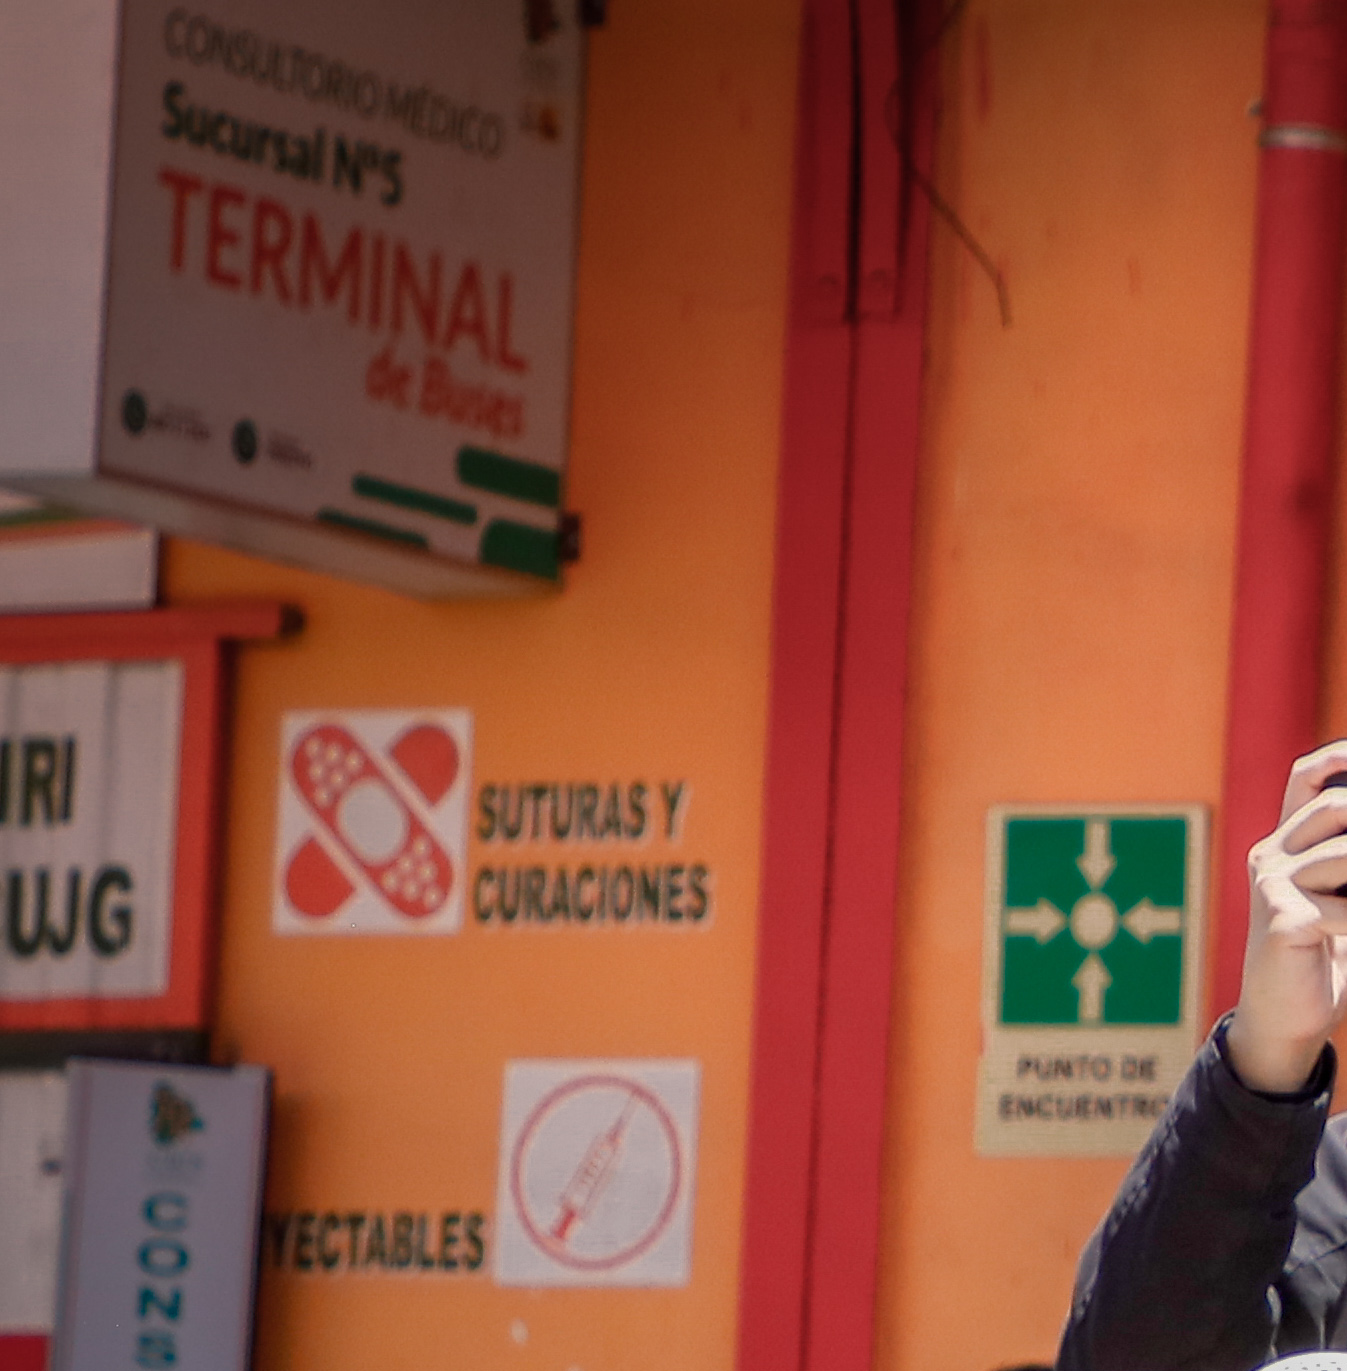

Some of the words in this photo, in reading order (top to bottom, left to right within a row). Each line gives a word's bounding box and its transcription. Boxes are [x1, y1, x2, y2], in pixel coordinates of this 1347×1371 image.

[162, 81, 325, 183] Sucursal
[158, 166, 528, 374] TERMINAL
[477, 781, 648, 842] SUTURAS
[661, 781, 686, 839] Y
[474, 863, 710, 924] CURACIONES
[1016, 1055, 1112, 1082] PUNTO
[1120, 1055, 1157, 1082] DE
[266, 1212, 485, 1270] YECTABLES
